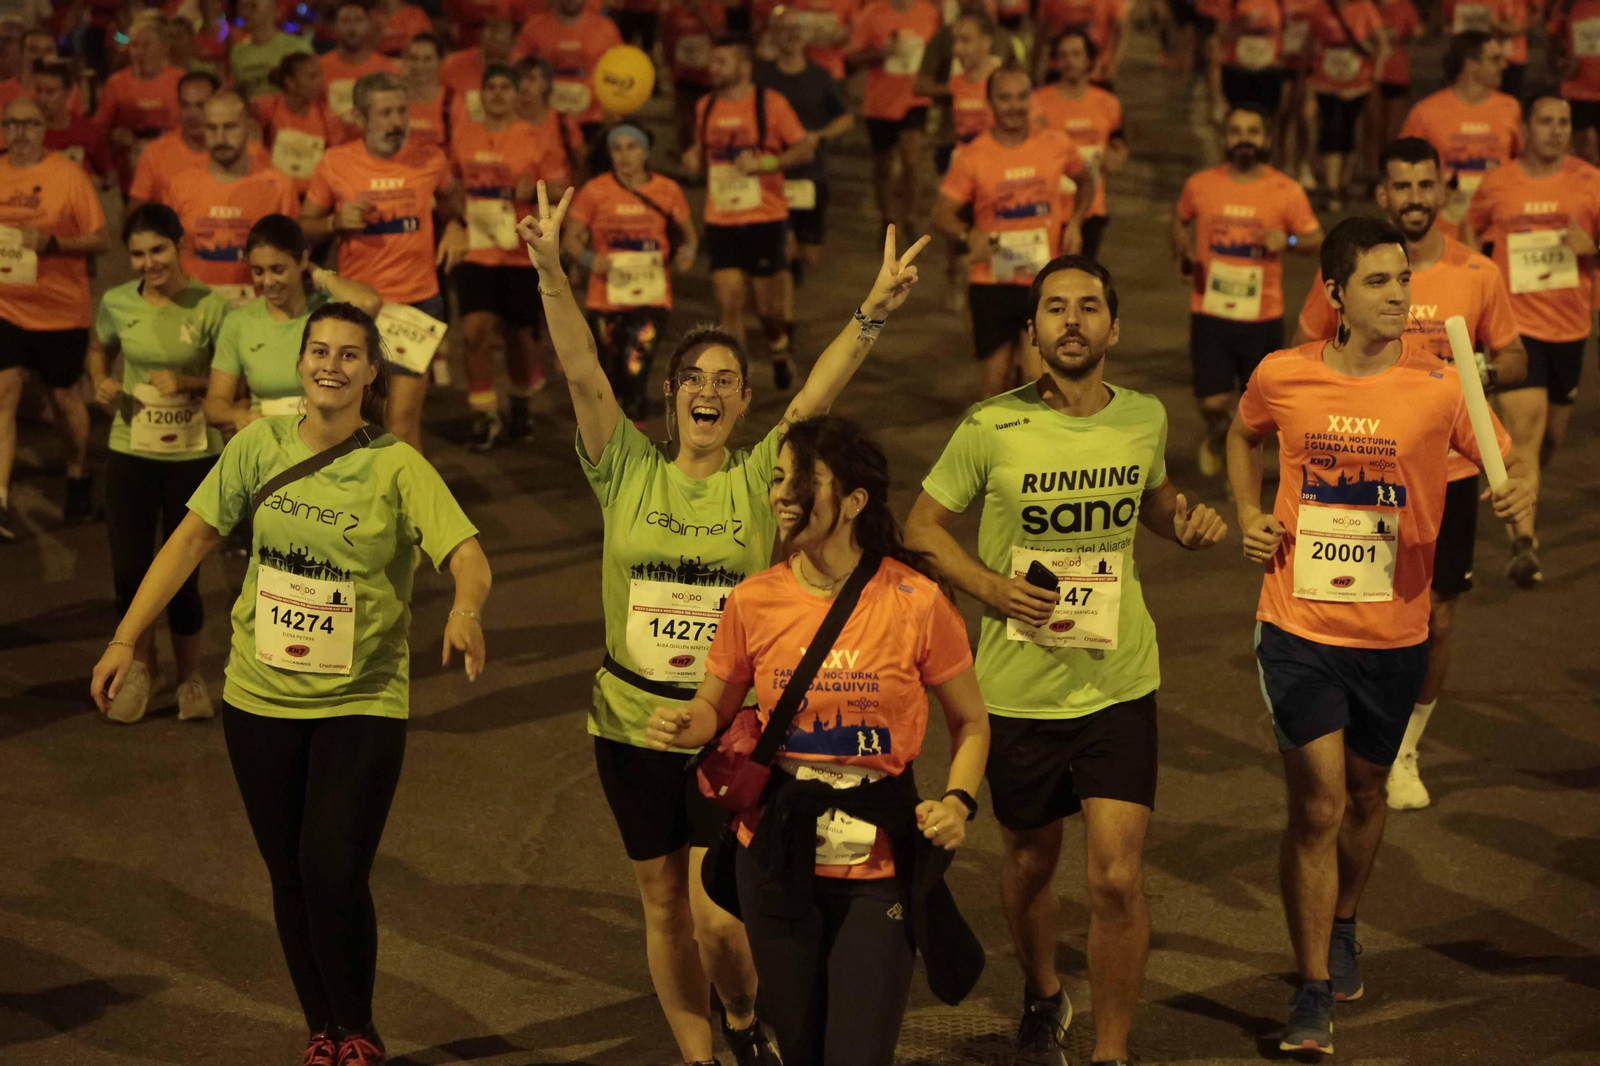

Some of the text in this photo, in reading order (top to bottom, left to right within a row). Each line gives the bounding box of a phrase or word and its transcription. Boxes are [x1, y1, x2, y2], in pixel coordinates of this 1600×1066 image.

[146, 409, 193, 424] 12060
[995, 419, 1021, 431] luanvi
[1327, 415, 1381, 435] XXXV
[1304, 432, 1397, 446] CARRERA NOCTURNA
[1310, 441, 1397, 457] GUADALQUIVIR
[1309, 457, 1332, 468] KH7
[1021, 465, 1140, 494] RUNNING
[1021, 497, 1136, 535] sano
[1078, 544, 1095, 553] del
[1311, 541, 1376, 563] 20001
[1333, 578, 1352, 586] KH7
[271, 605, 334, 635] 14274
[649, 618, 718, 642] 14273
[288, 646, 306, 656] KH7
[823, 671, 880, 680] NOCTURNA
[778, 679, 880, 693] GDALQUIVIR
